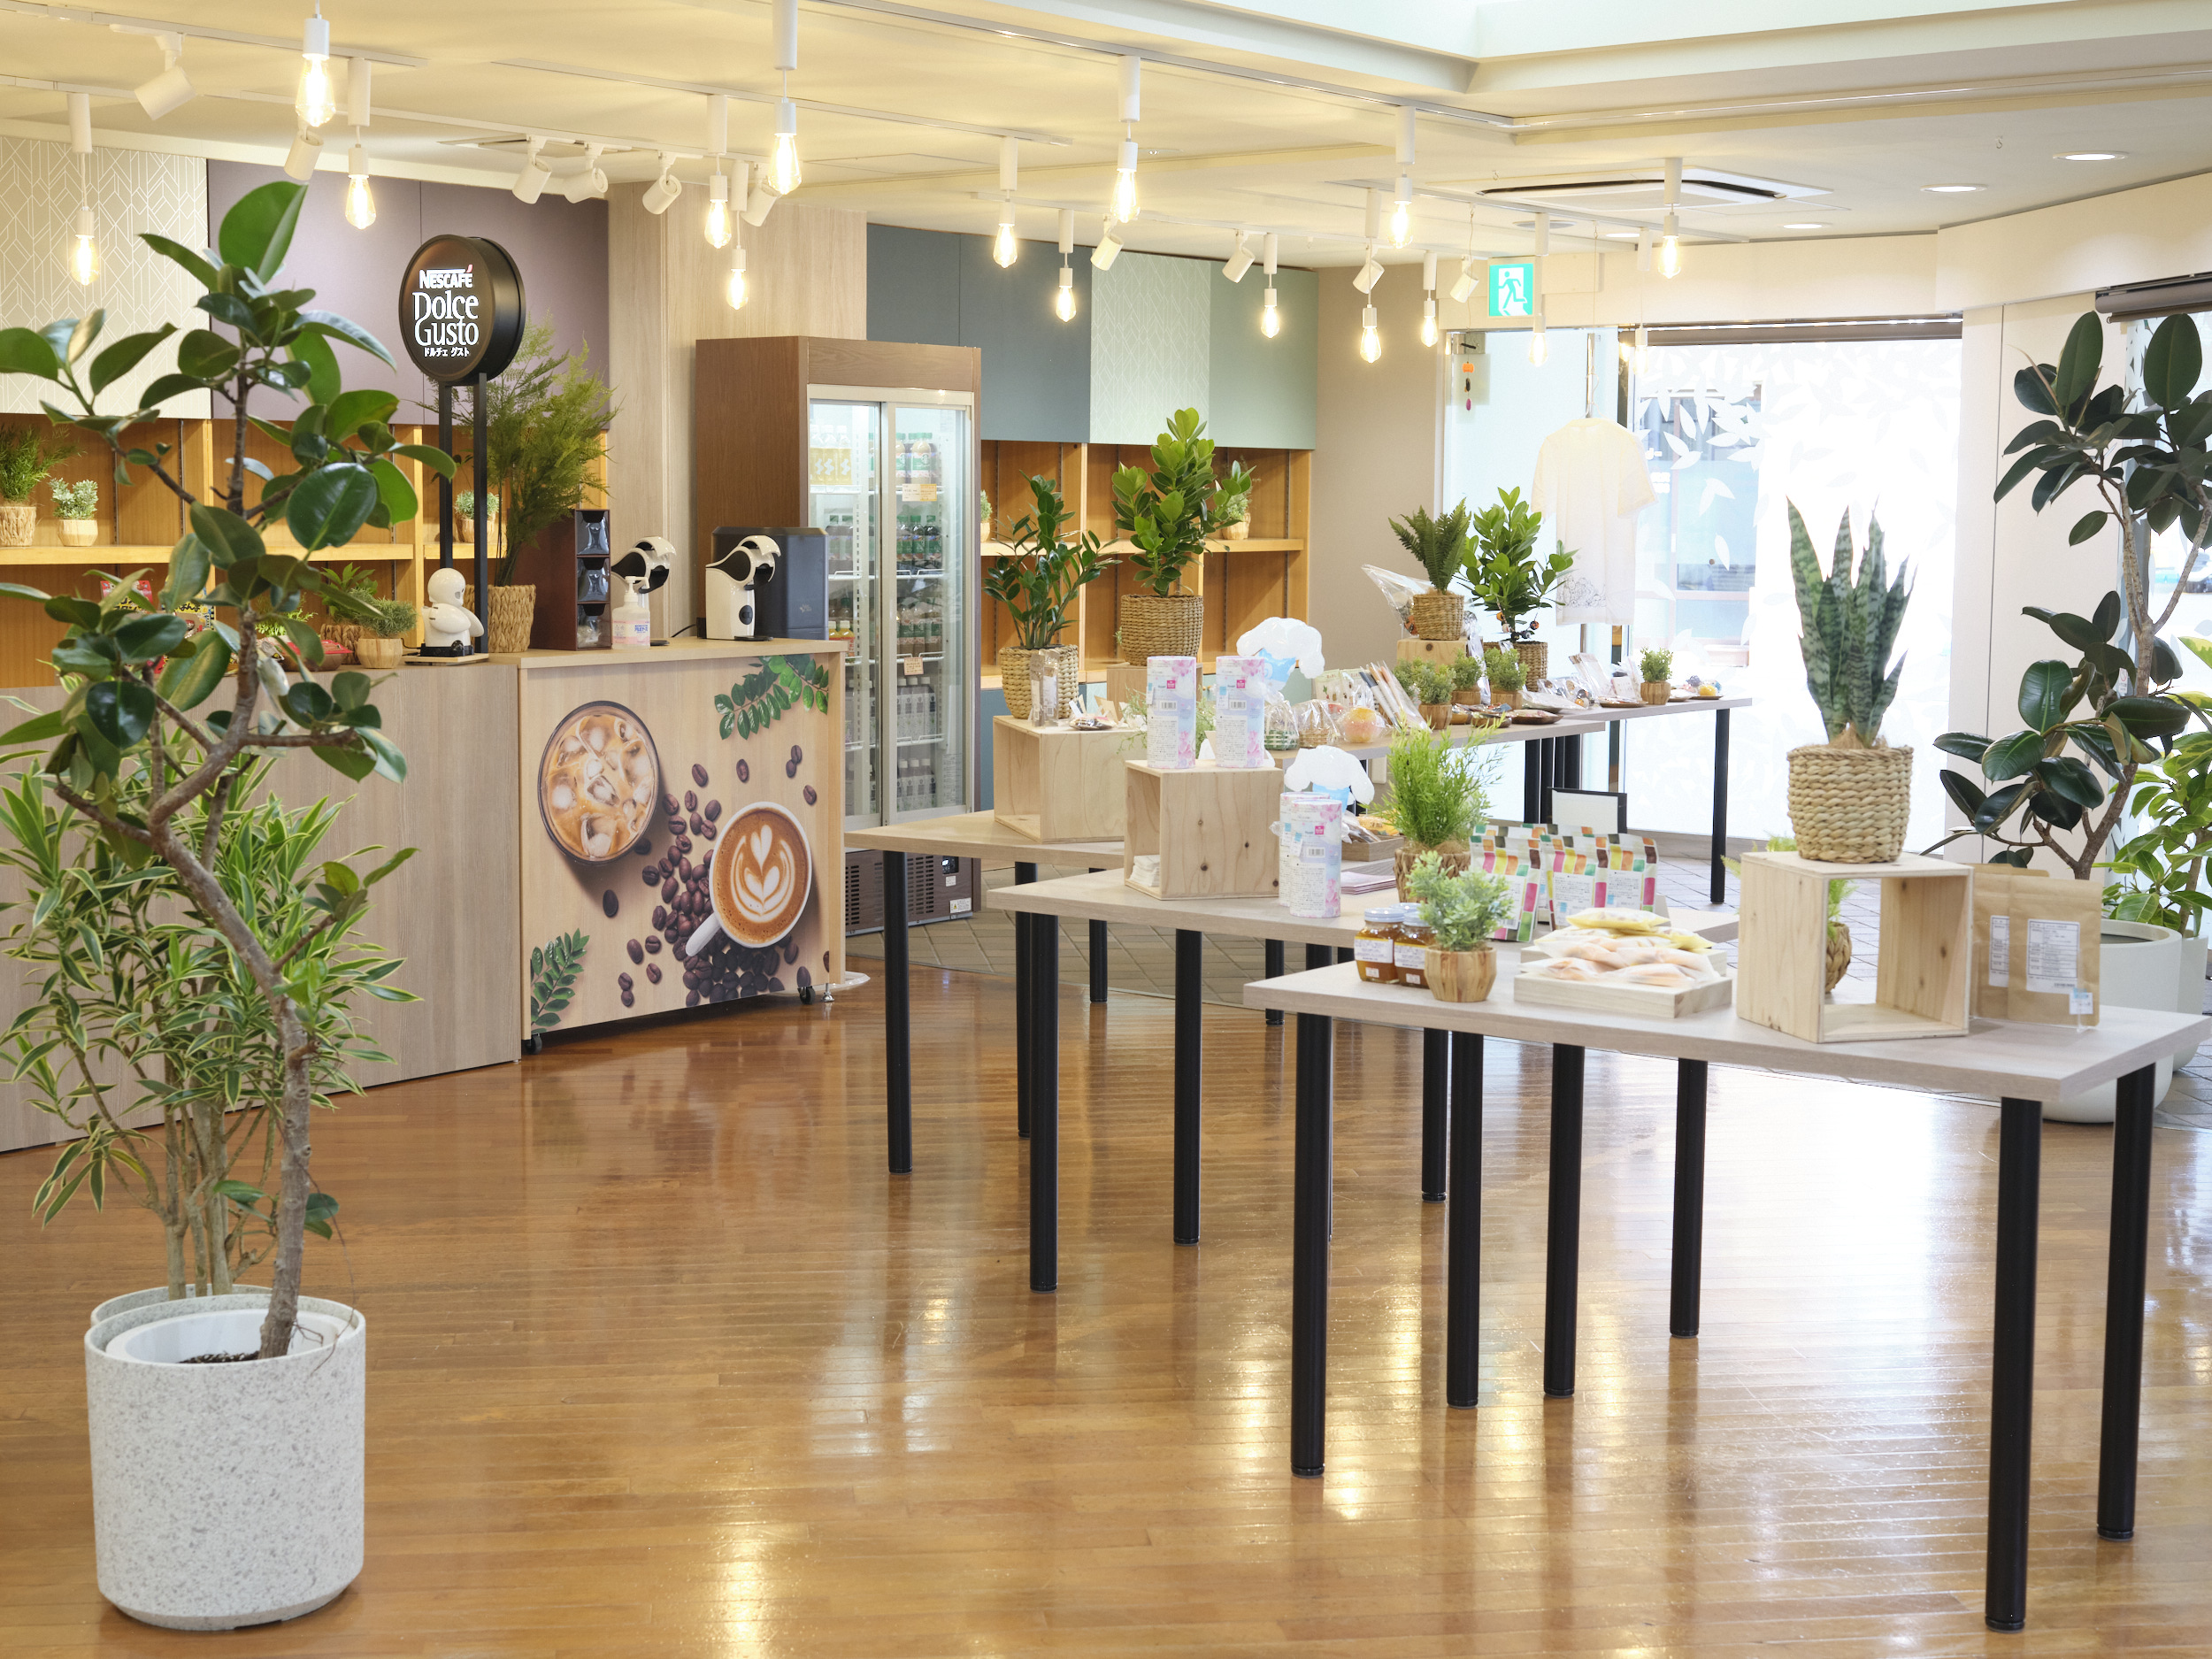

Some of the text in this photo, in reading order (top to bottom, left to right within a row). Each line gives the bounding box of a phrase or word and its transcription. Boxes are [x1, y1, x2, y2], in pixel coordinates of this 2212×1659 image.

[419, 265, 472, 288] NESCAFÉ
[412, 290, 479, 320] Dolce
[415, 318, 479, 346] Gusto
[451, 347, 470, 357] グスト
